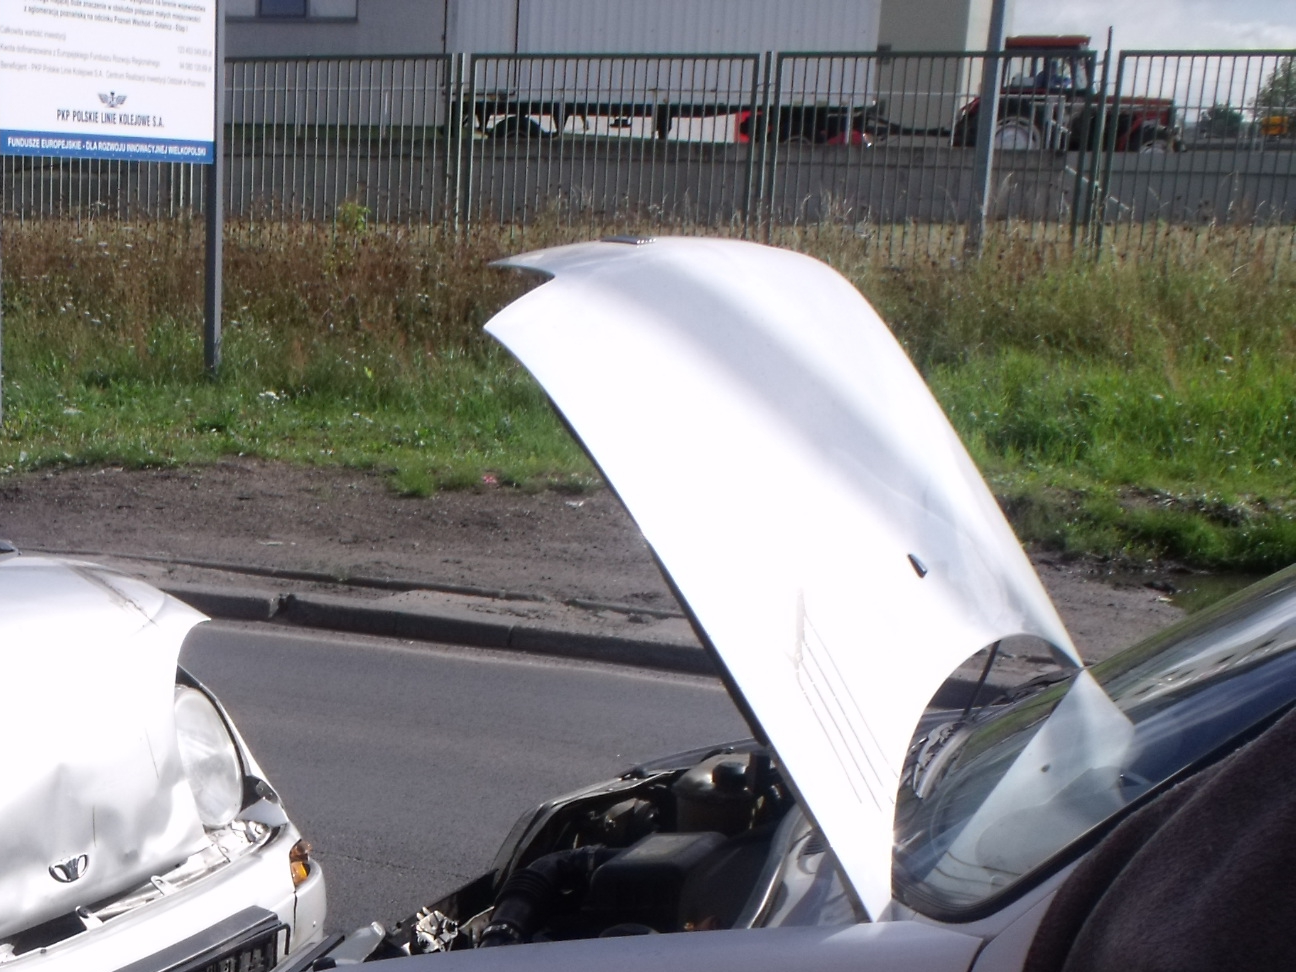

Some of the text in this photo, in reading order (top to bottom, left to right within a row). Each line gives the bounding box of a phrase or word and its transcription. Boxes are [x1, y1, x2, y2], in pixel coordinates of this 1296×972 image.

[57, 109, 165, 128] PKP POLSKIE LINIE KOLEJOWE S.A.
[7, 137, 40, 148] FUNDUSZE
[41, 138, 81, 150] EUROPEJSKIE
